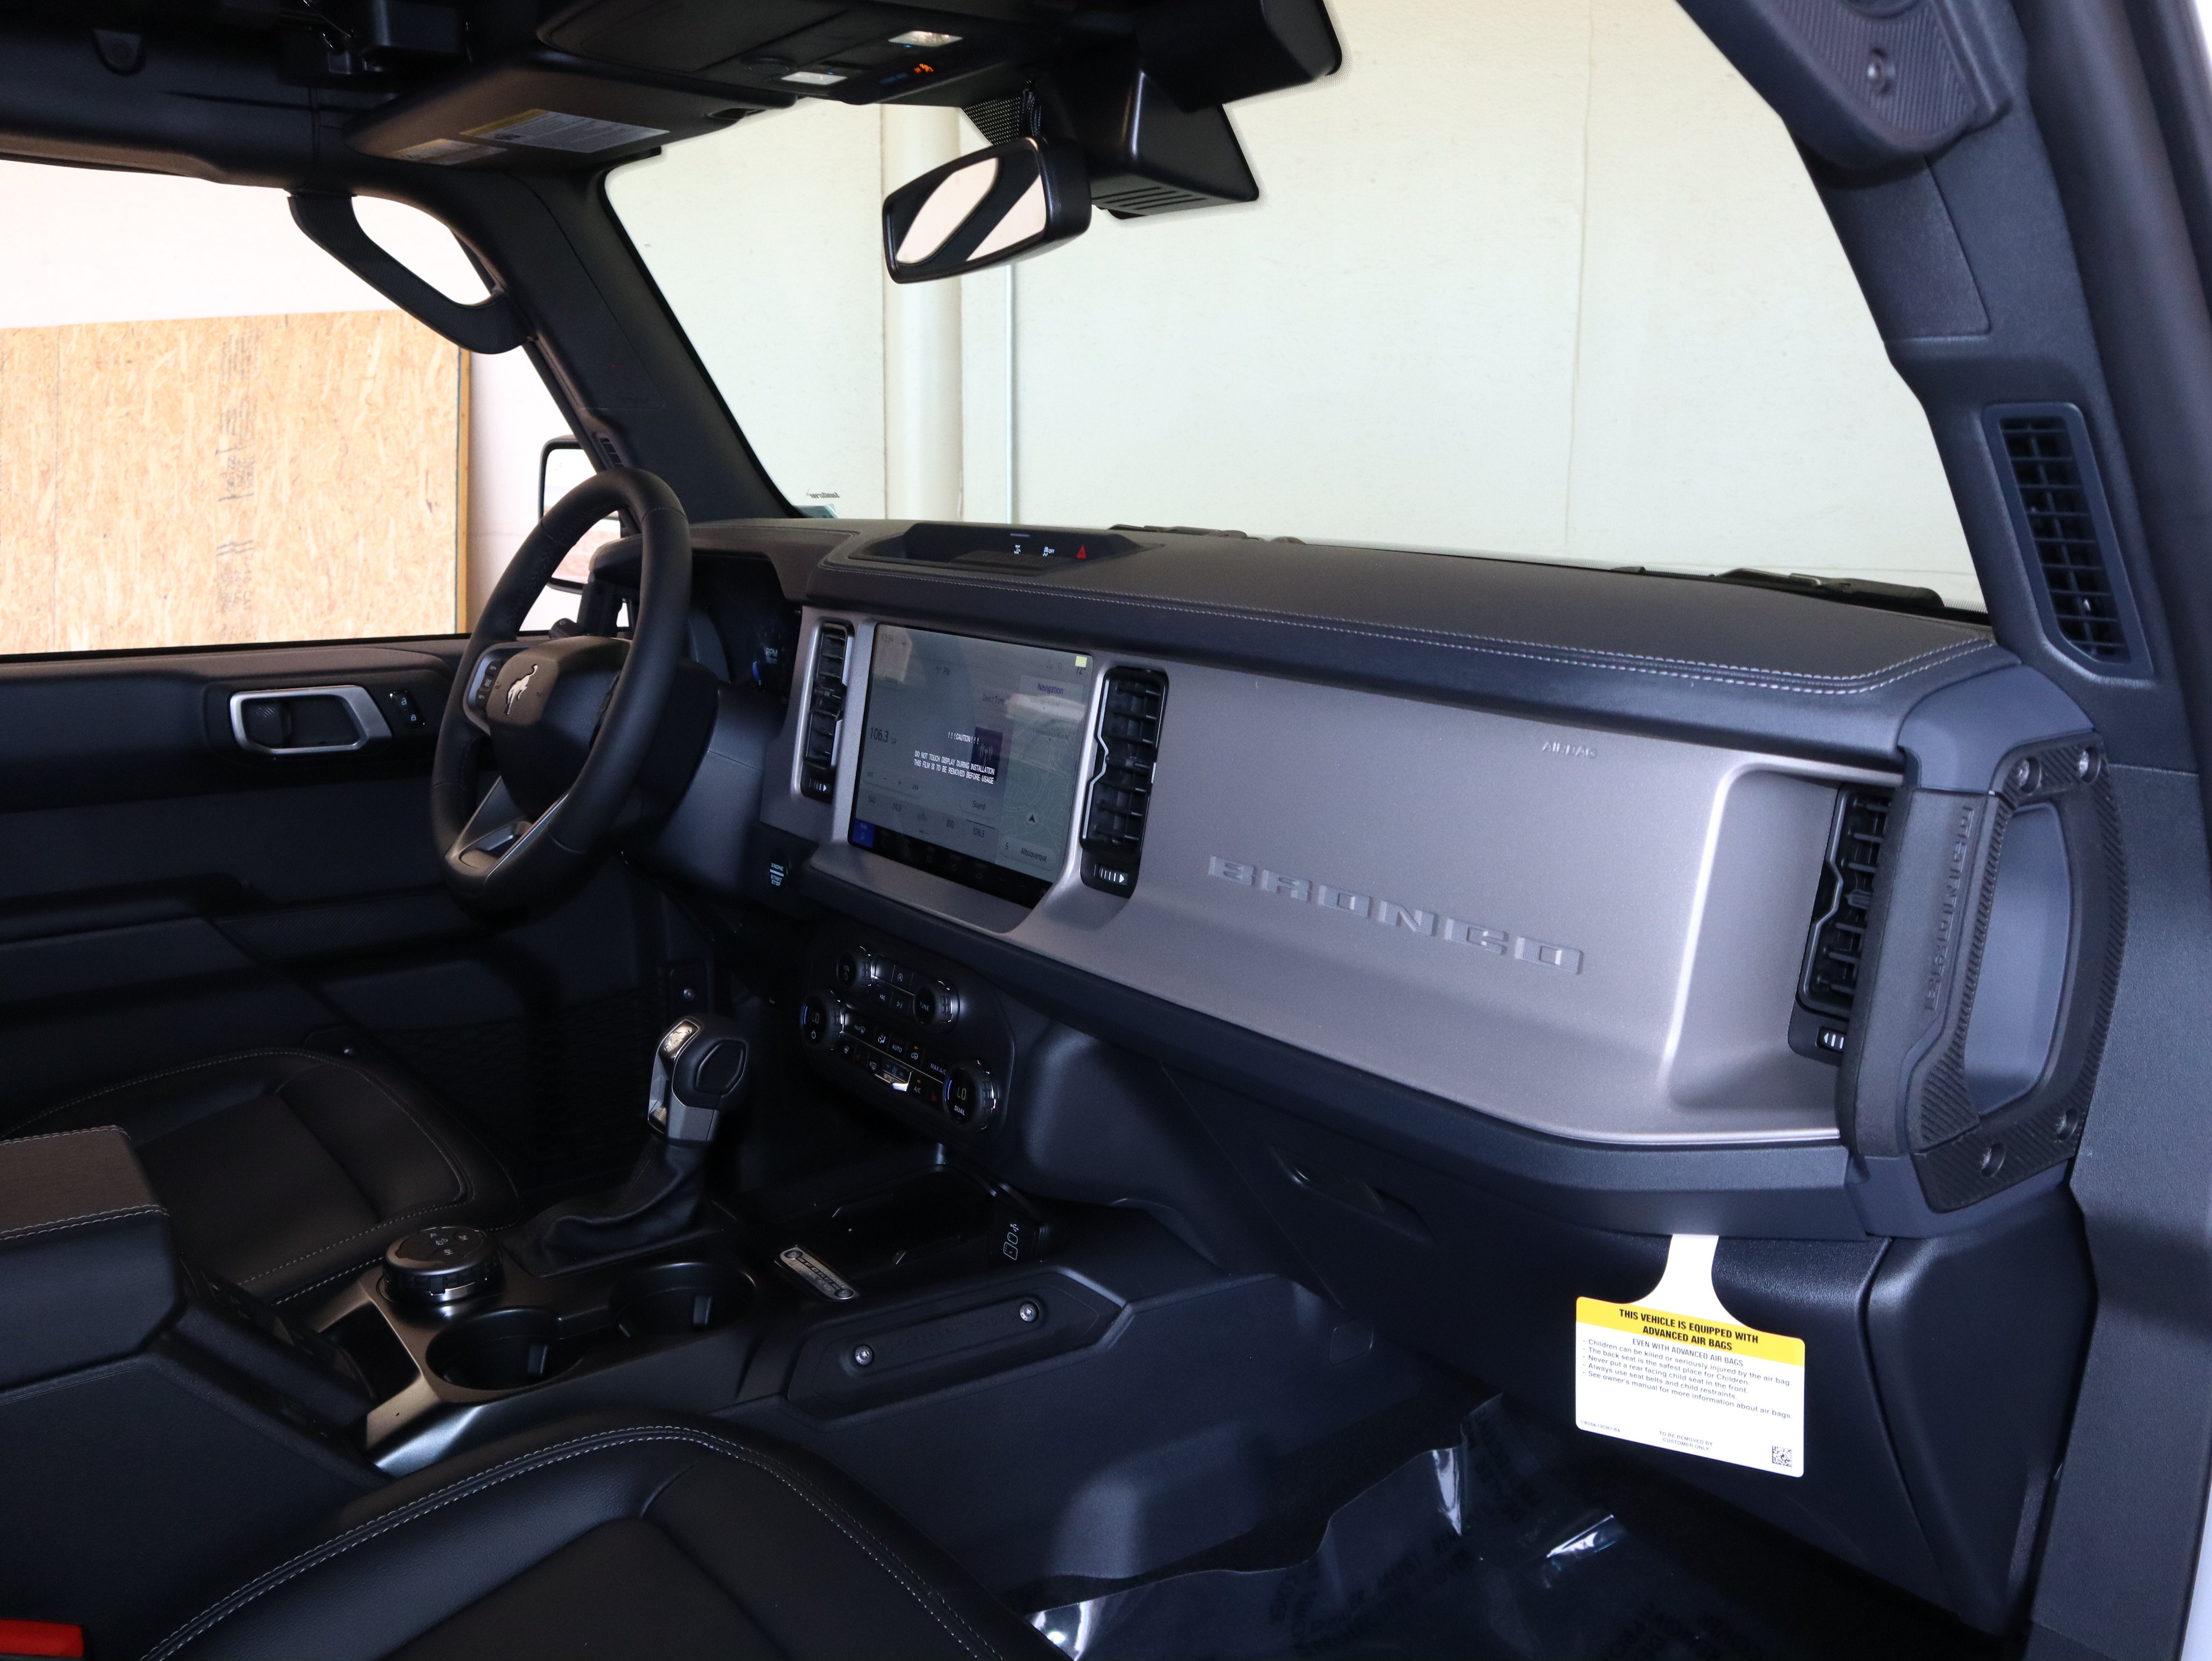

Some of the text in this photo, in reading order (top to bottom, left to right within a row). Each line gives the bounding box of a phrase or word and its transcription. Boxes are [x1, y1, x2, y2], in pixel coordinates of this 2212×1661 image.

[766, 647, 778, 657] RPM
[1037, 682, 1064, 695] Navigation
[870, 727, 889, 742] 106.3
[929, 753, 940, 762] TOUCH
[941, 756, 955, 767] DISPLAY
[956, 760, 970, 769] DURING
[970, 763, 995, 775] INSTALLATION
[948, 767, 965, 777] REMOVED
[966, 772, 981, 781] BEFORE
[981, 775, 994, 784] USAGE
[972, 800, 986, 811] Sound
[1020, 848, 1047, 862] Albuquerque
[1207, 855, 1584, 975] BRONCO
[919, 1002, 930, 1012] TUNE
[892, 1044, 902, 1053] AUTO
[930, 1063, 940, 1072] MAX
[957, 1087, 967, 1100] LO
[954, 1105, 966, 1116] DUAL
[805, 1261, 834, 1286] FORD
[1619, 1309, 1758, 1343] THIS VEHICLE IS EQUIPPED WITH
[1643, 1326, 1732, 1350] ADVANCED AIR BAGS
[1632, 1338, 1743, 1367] EVEN WITH ADVANCED AIR BAGS
[1588, 1339, 1617, 1350] Children
[1644, 1350, 1663, 1360] killed
[1675, 1358, 1708, 1370] seriously
[1710, 1365, 1736, 1374] injured
[1738, 1369, 1747, 1378] by
[1776, 1377, 1792, 1387] bag.
[1603, 1350, 1619, 1358] back
[1659, 1363, 1680, 1372] safest
[1717, 1374, 1750, 1385] Children.
[1588, 1355, 1608, 1364] Never
[1645, 1367, 1667, 1378] facing
[1729, 1384, 1748, 1393] front.
[1588, 1363, 1613, 1373] Always
[1646, 1375, 1663, 1384] belts
[1701, 1388, 1737, 1399] restraints.
[1588, 1370, 1601, 1379] See
[1603, 1373, 1630, 1385] owner's
[1632, 1382, 1657, 1391] manual
[1692, 1394, 1734, 1407] information
[1737, 1403, 1757, 1412] about
[1772, 1409, 1793, 1419] bags.
[1663, 1438, 1693, 1448] CUSTOMER
[1676, 1435, 1704, 1444] REMOVED
